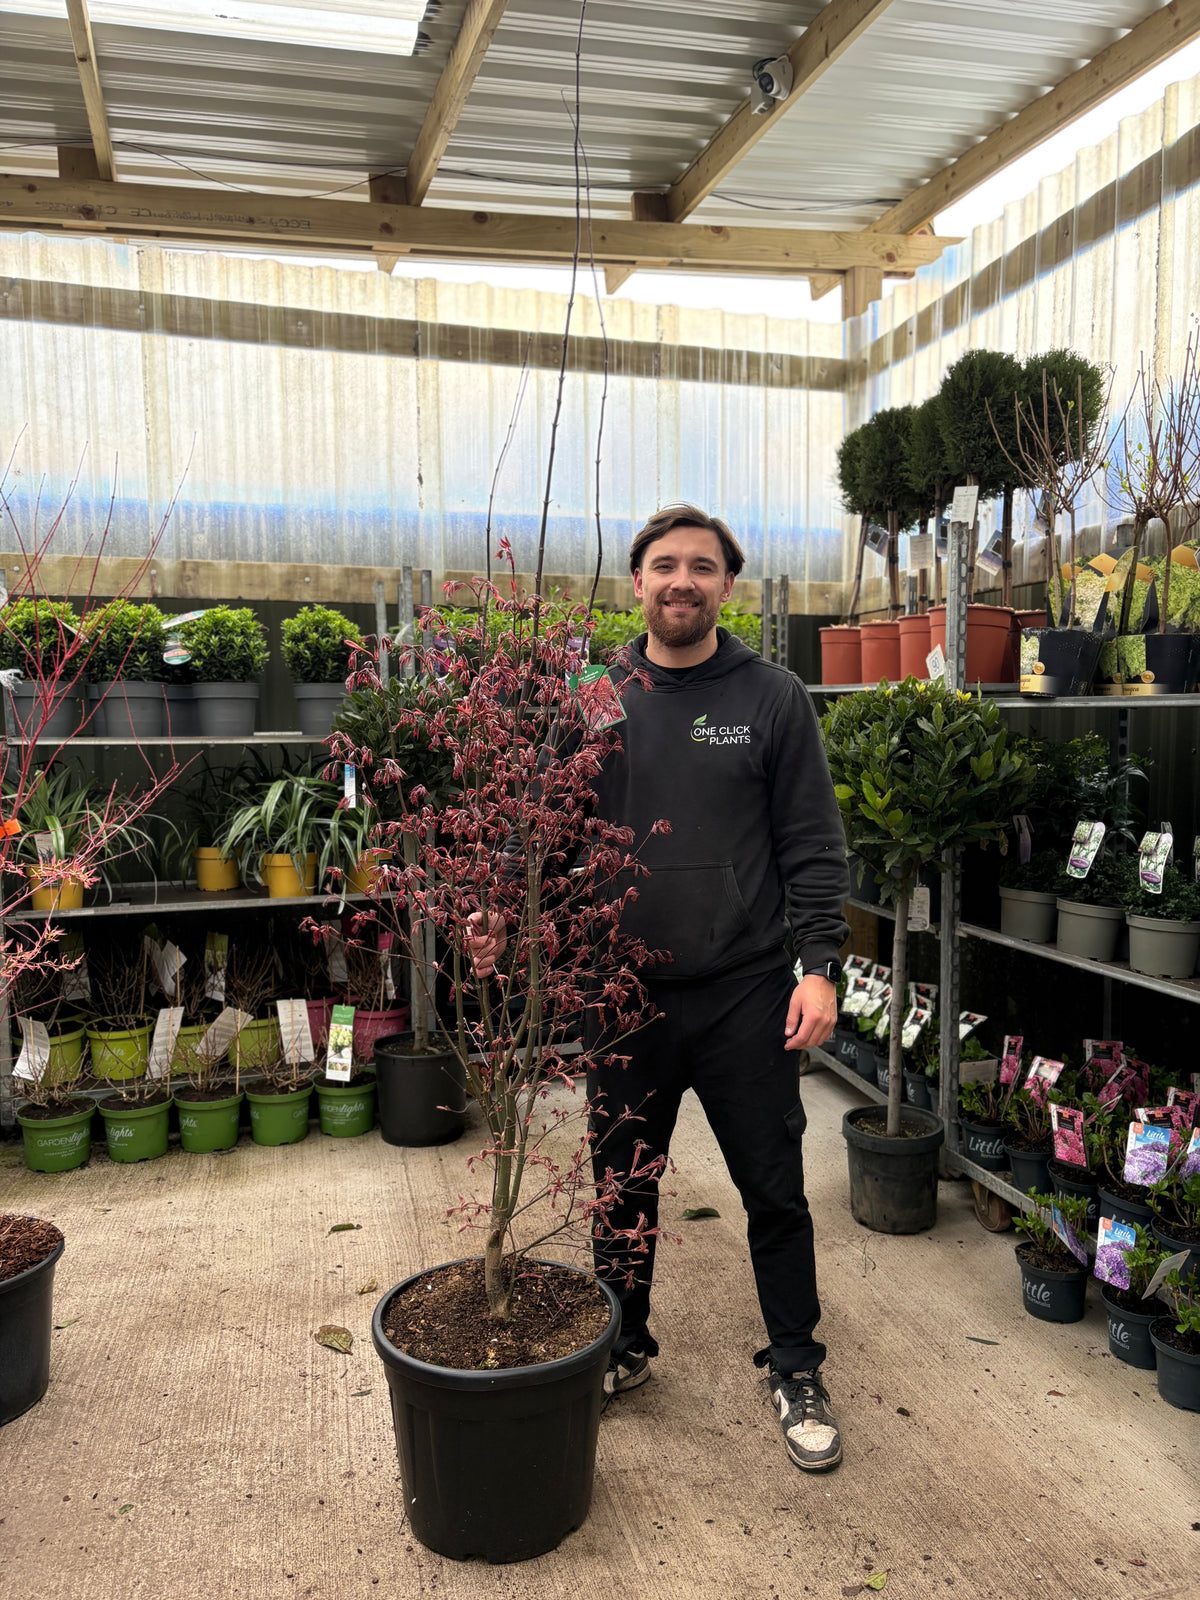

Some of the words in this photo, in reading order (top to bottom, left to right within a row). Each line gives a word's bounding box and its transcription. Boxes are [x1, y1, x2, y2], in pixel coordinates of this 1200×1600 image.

[693, 726, 717, 737] ONE
[718, 725, 751, 735] CLICK
[709, 735, 751, 746] PLANTS
[968, 1136, 1004, 1154] Little
[1023, 1277, 1051, 1302] ittle
[1109, 1319, 1131, 1343] ttle
